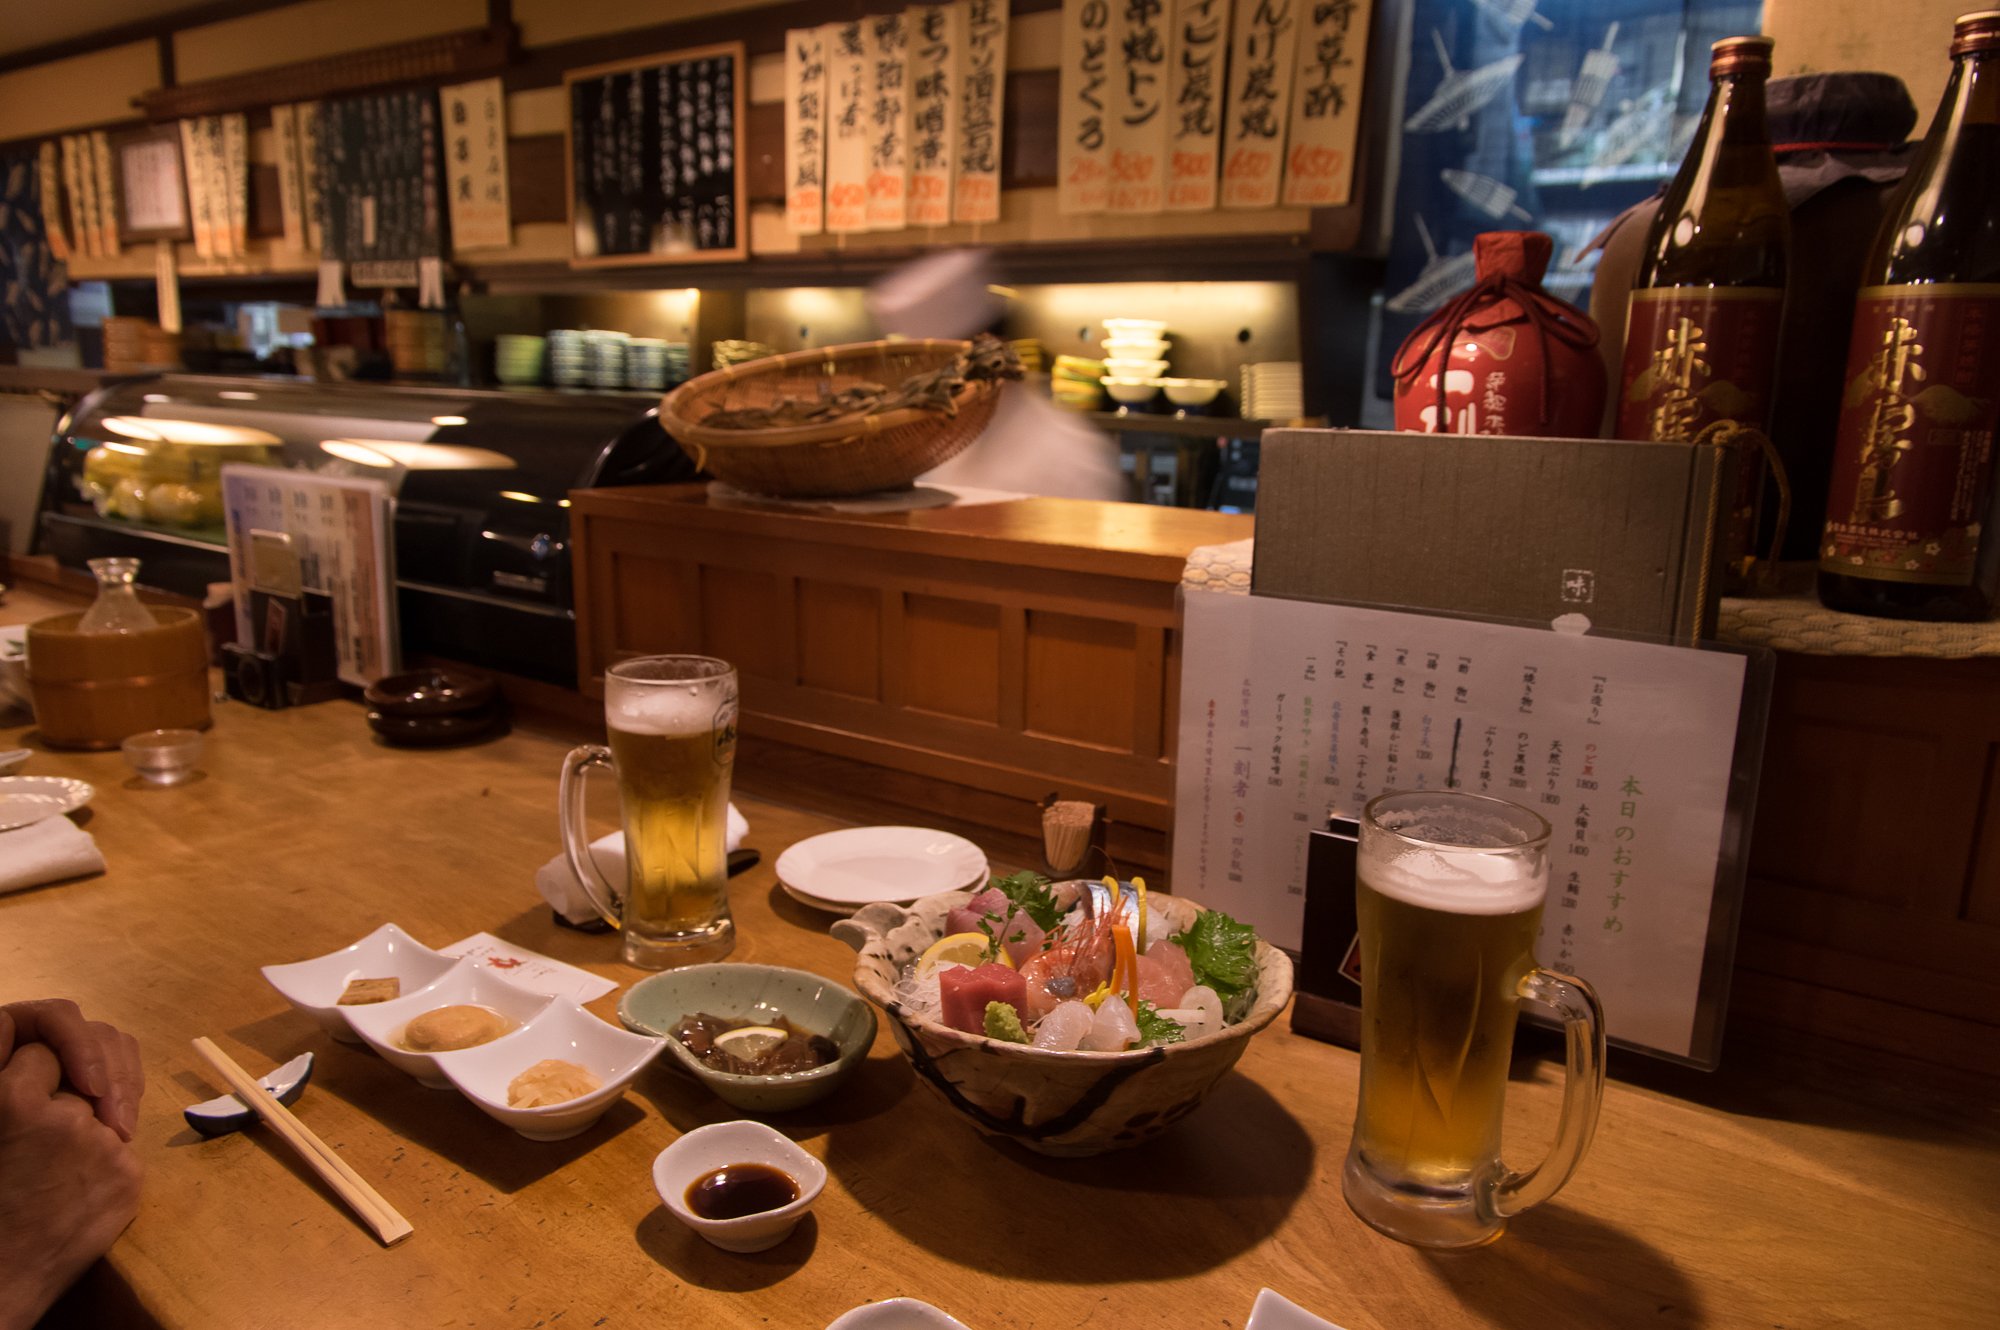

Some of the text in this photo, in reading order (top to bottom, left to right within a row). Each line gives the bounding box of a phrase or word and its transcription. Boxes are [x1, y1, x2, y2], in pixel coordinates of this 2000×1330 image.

[1603, 775, 1644, 933] 本日のおすすめ
